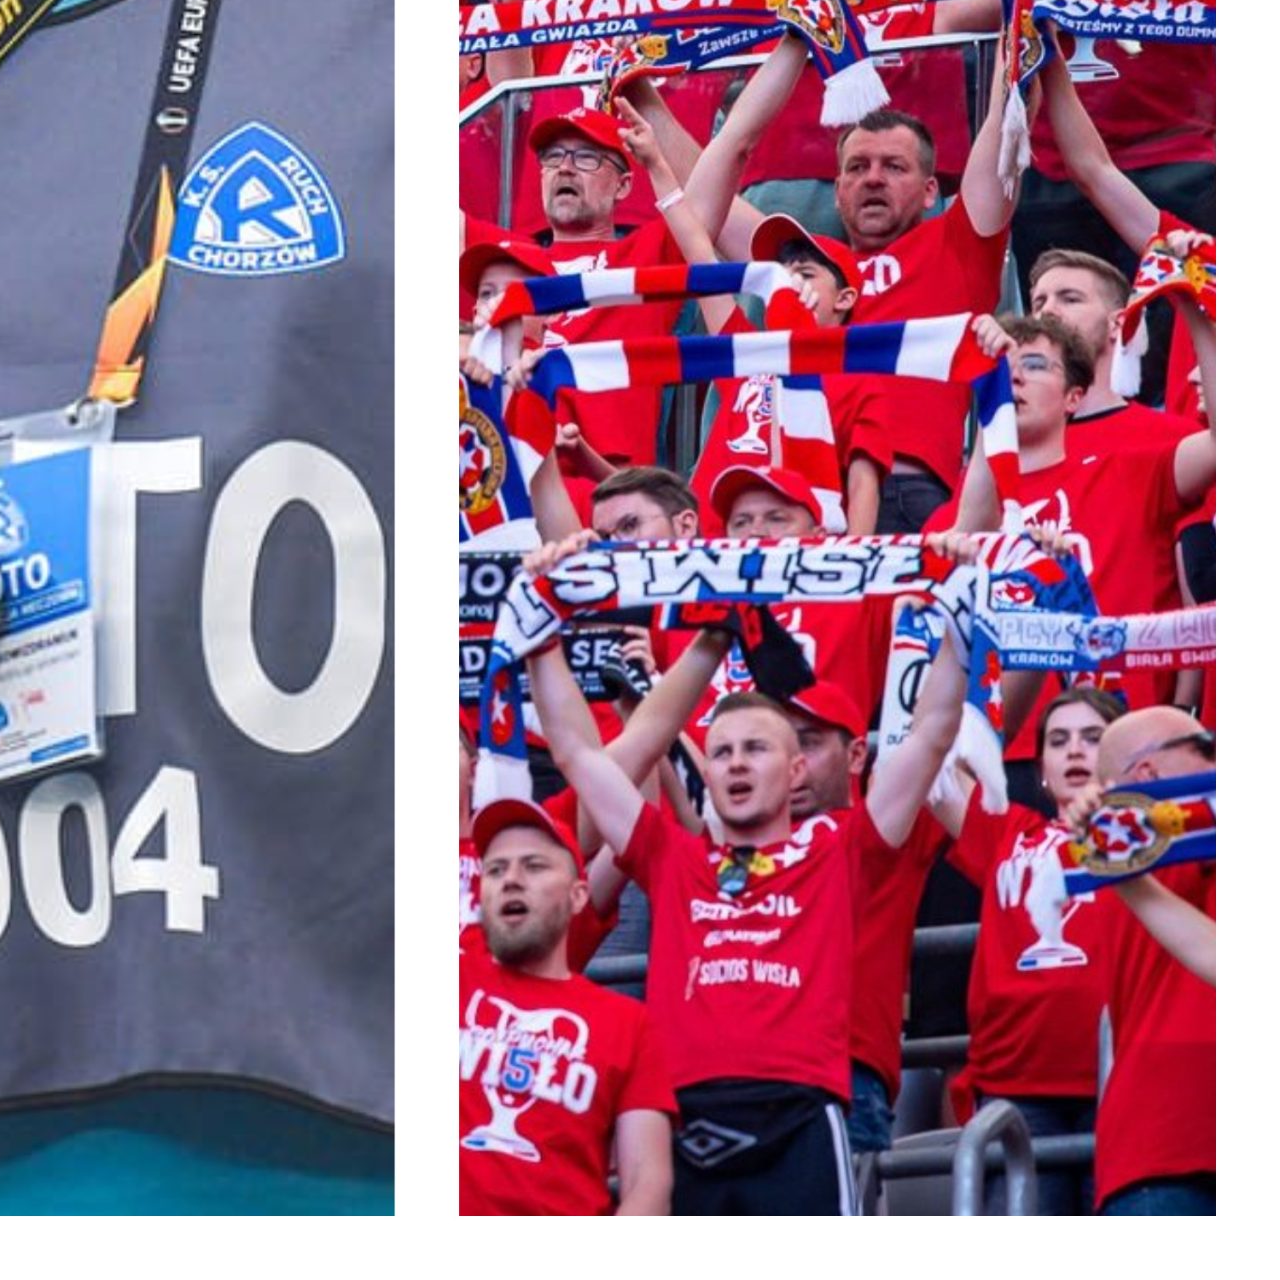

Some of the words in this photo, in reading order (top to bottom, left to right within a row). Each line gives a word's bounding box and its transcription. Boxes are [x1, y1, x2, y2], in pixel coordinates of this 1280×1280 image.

[531, 18, 638, 43] GWIAZDA
[168, 35, 201, 94] UEFA
[279, 154, 329, 216] RUCH
[187, 242, 319, 270] CHORZÓW
